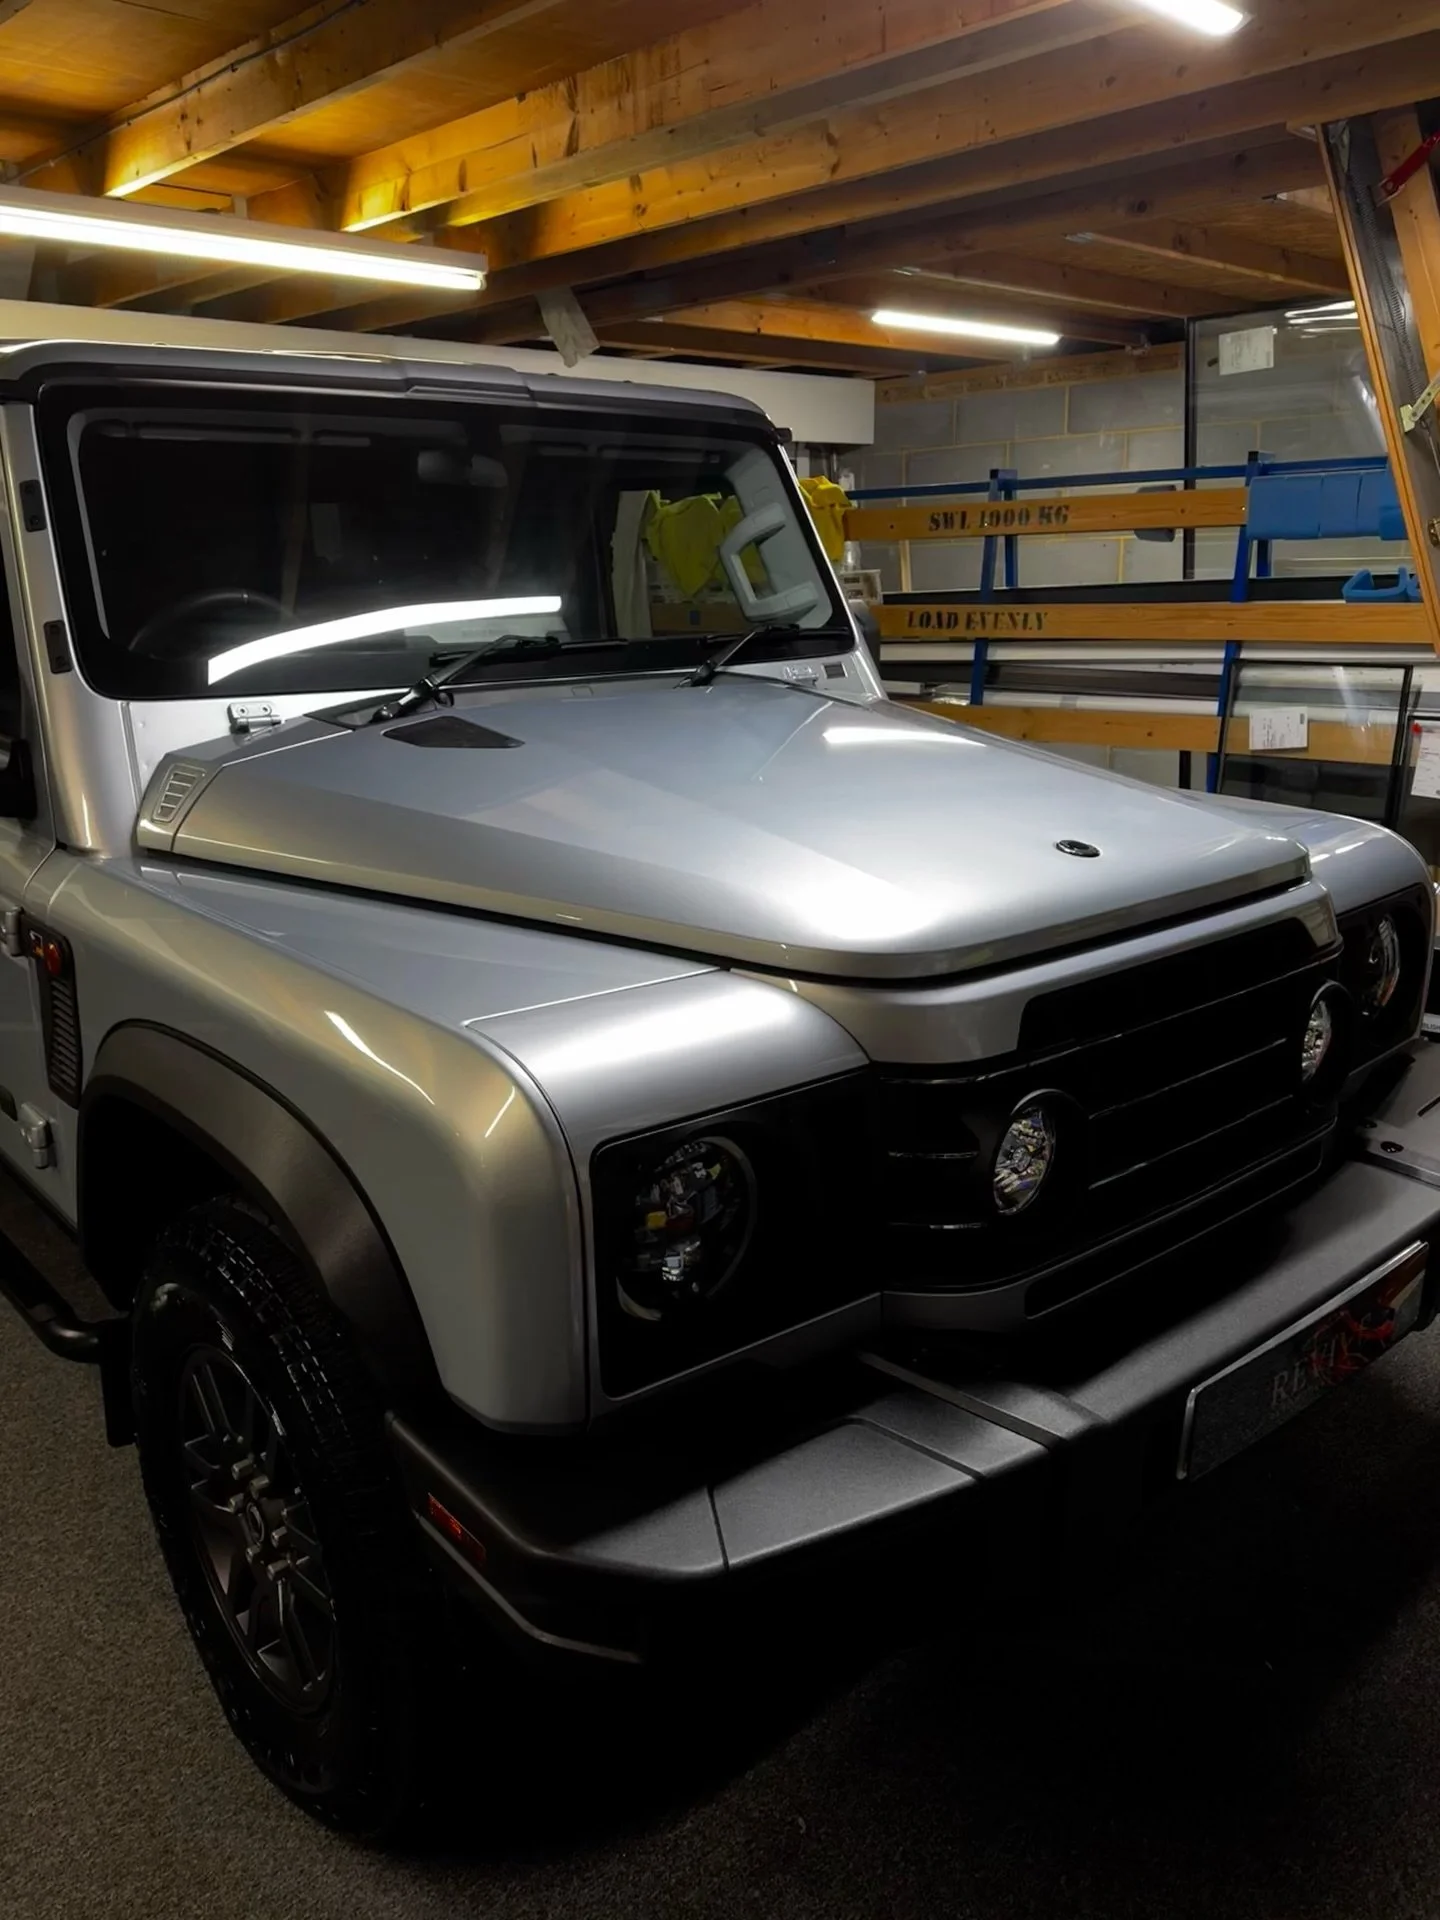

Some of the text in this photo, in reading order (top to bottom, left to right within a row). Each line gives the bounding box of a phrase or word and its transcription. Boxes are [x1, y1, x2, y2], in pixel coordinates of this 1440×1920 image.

[928, 504, 1070, 531] SWL 1000 KG
[907, 610, 1048, 630] LOAD EVENLY
